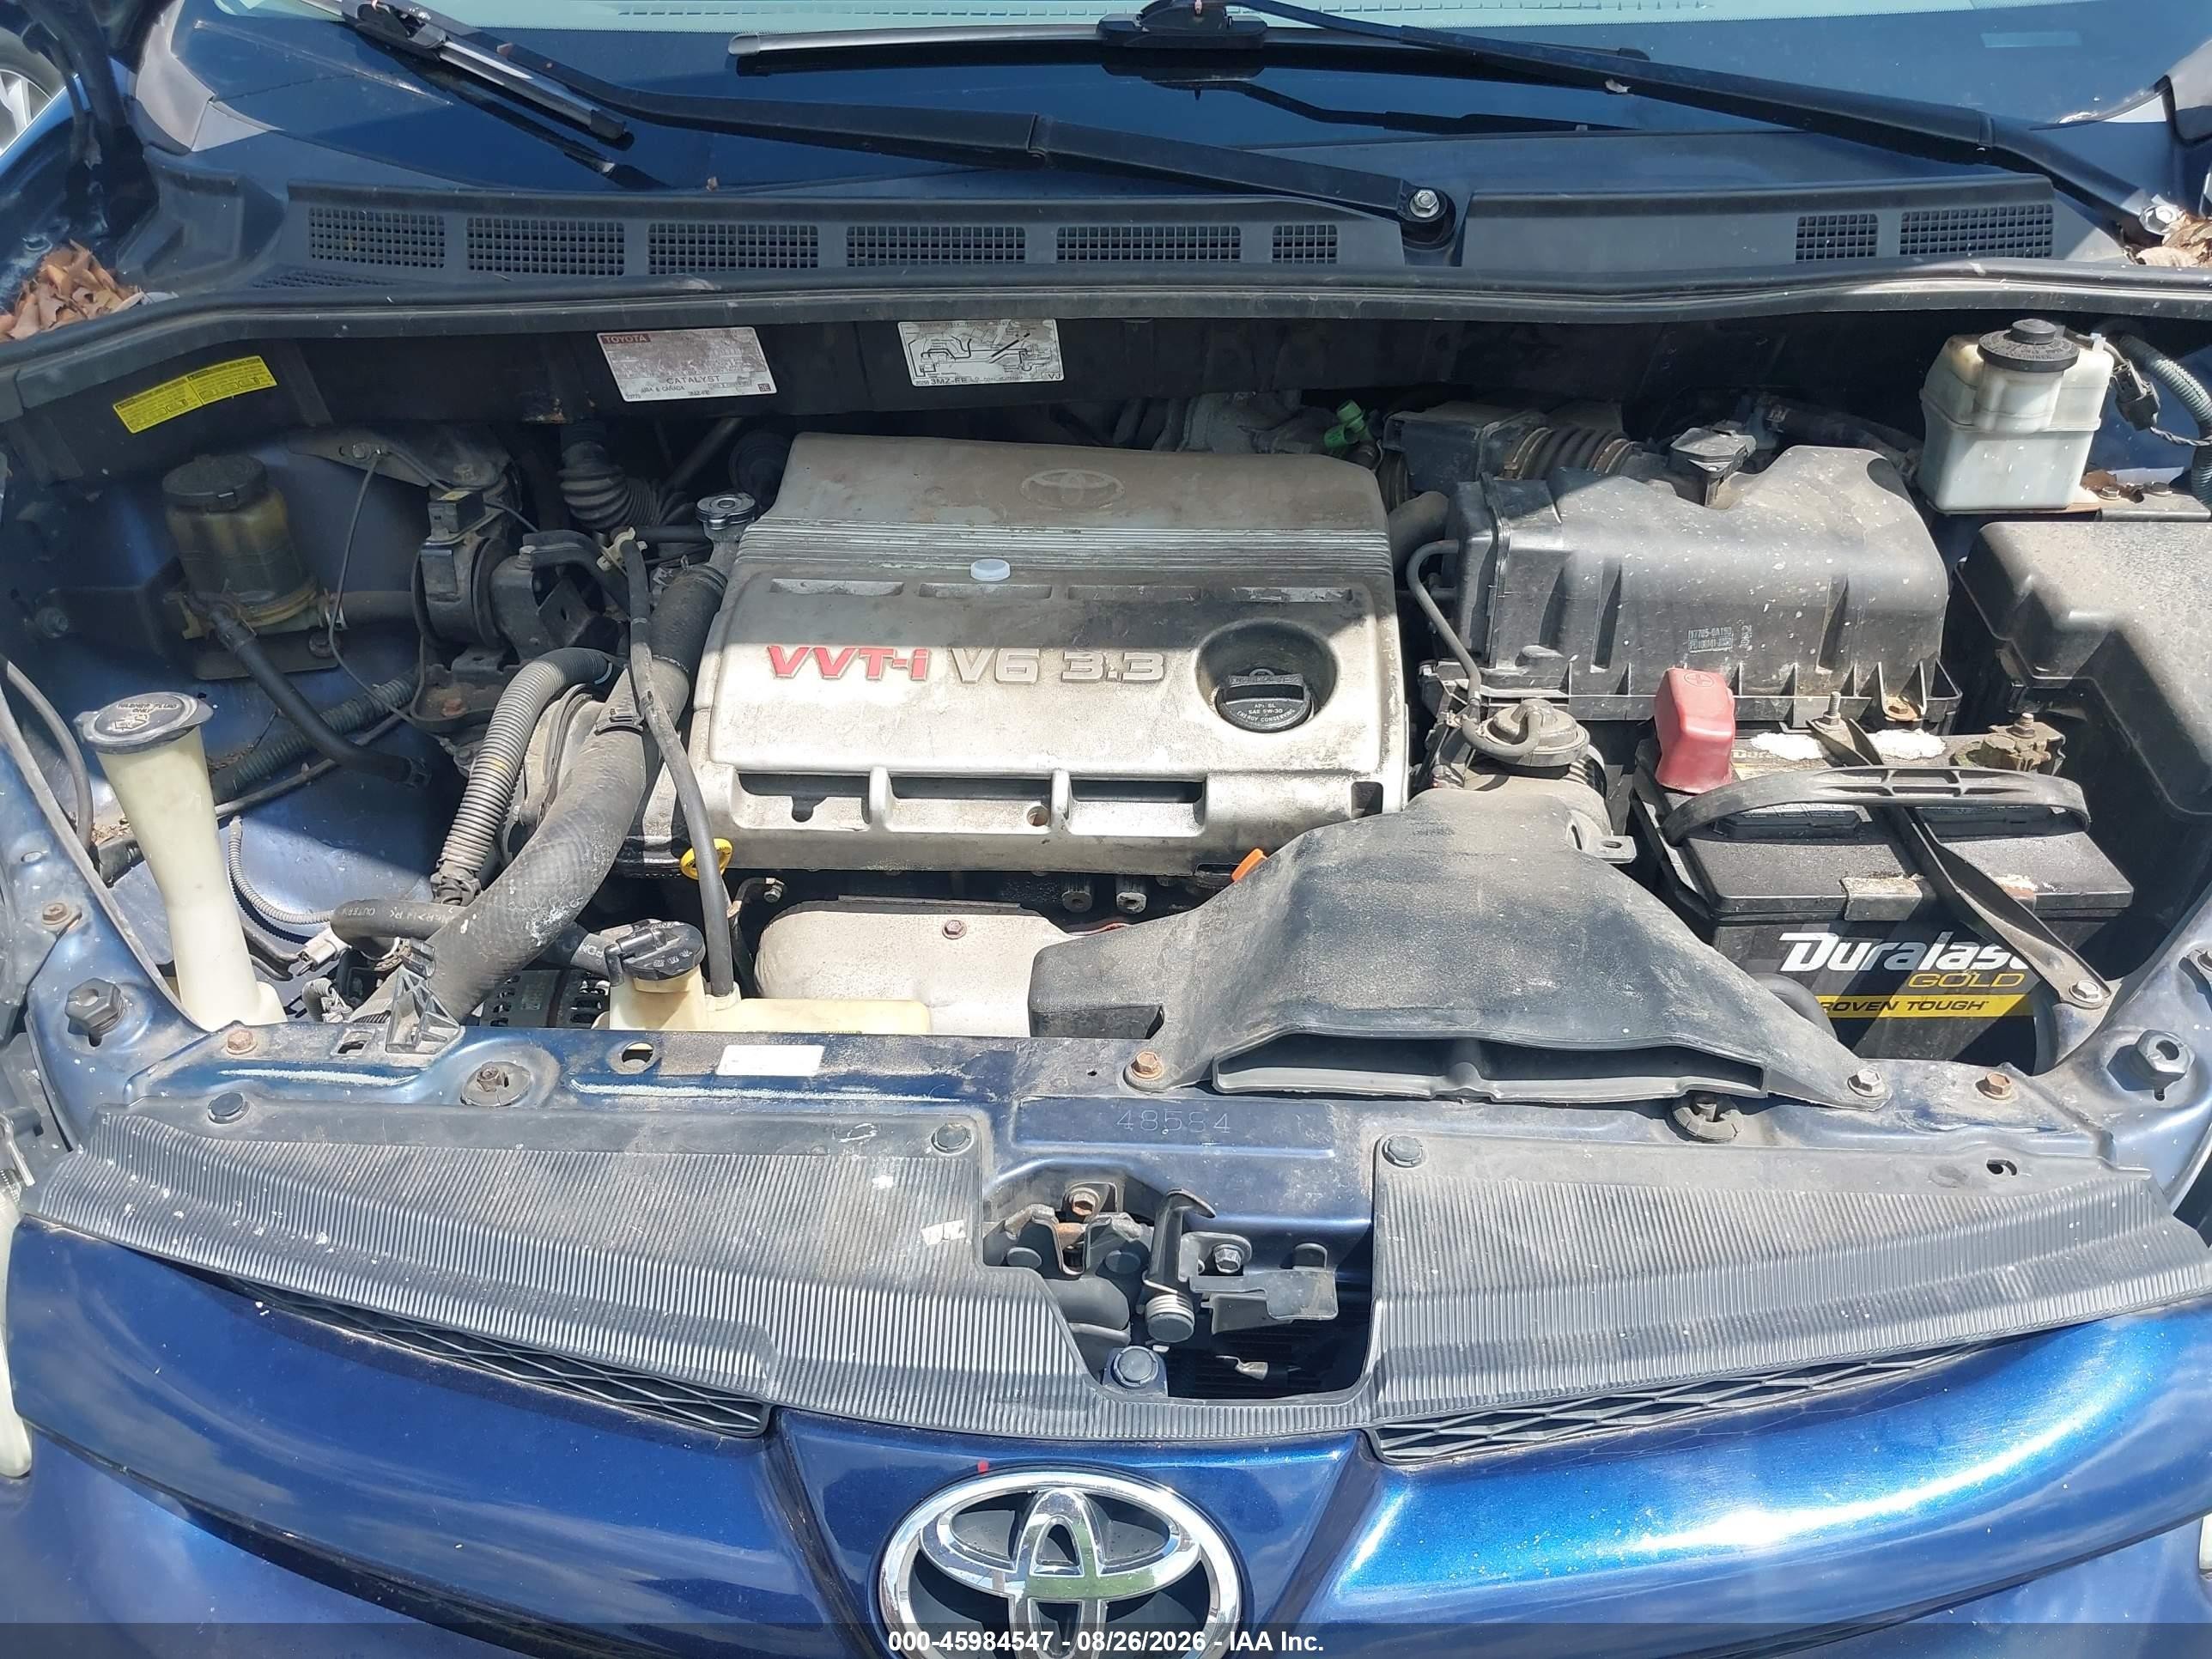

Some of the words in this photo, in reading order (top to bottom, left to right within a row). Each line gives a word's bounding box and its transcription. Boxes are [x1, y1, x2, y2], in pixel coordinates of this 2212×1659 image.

[605, 334, 647, 343] TOYOTA
[666, 374, 720, 385] CATALYST
[930, 377, 968, 386] 3MZ-FE
[767, 645, 931, 680] VVT-i
[950, 647, 1042, 684] V6
[1060, 650, 1165, 684] 3.3
[1907, 972, 2025, 988] GOLD
[1820, 1000, 1899, 1012] ROVEN
[1906, 1000, 1984, 1012] TOUGH
[1116, 1109, 1231, 1133] 48584
